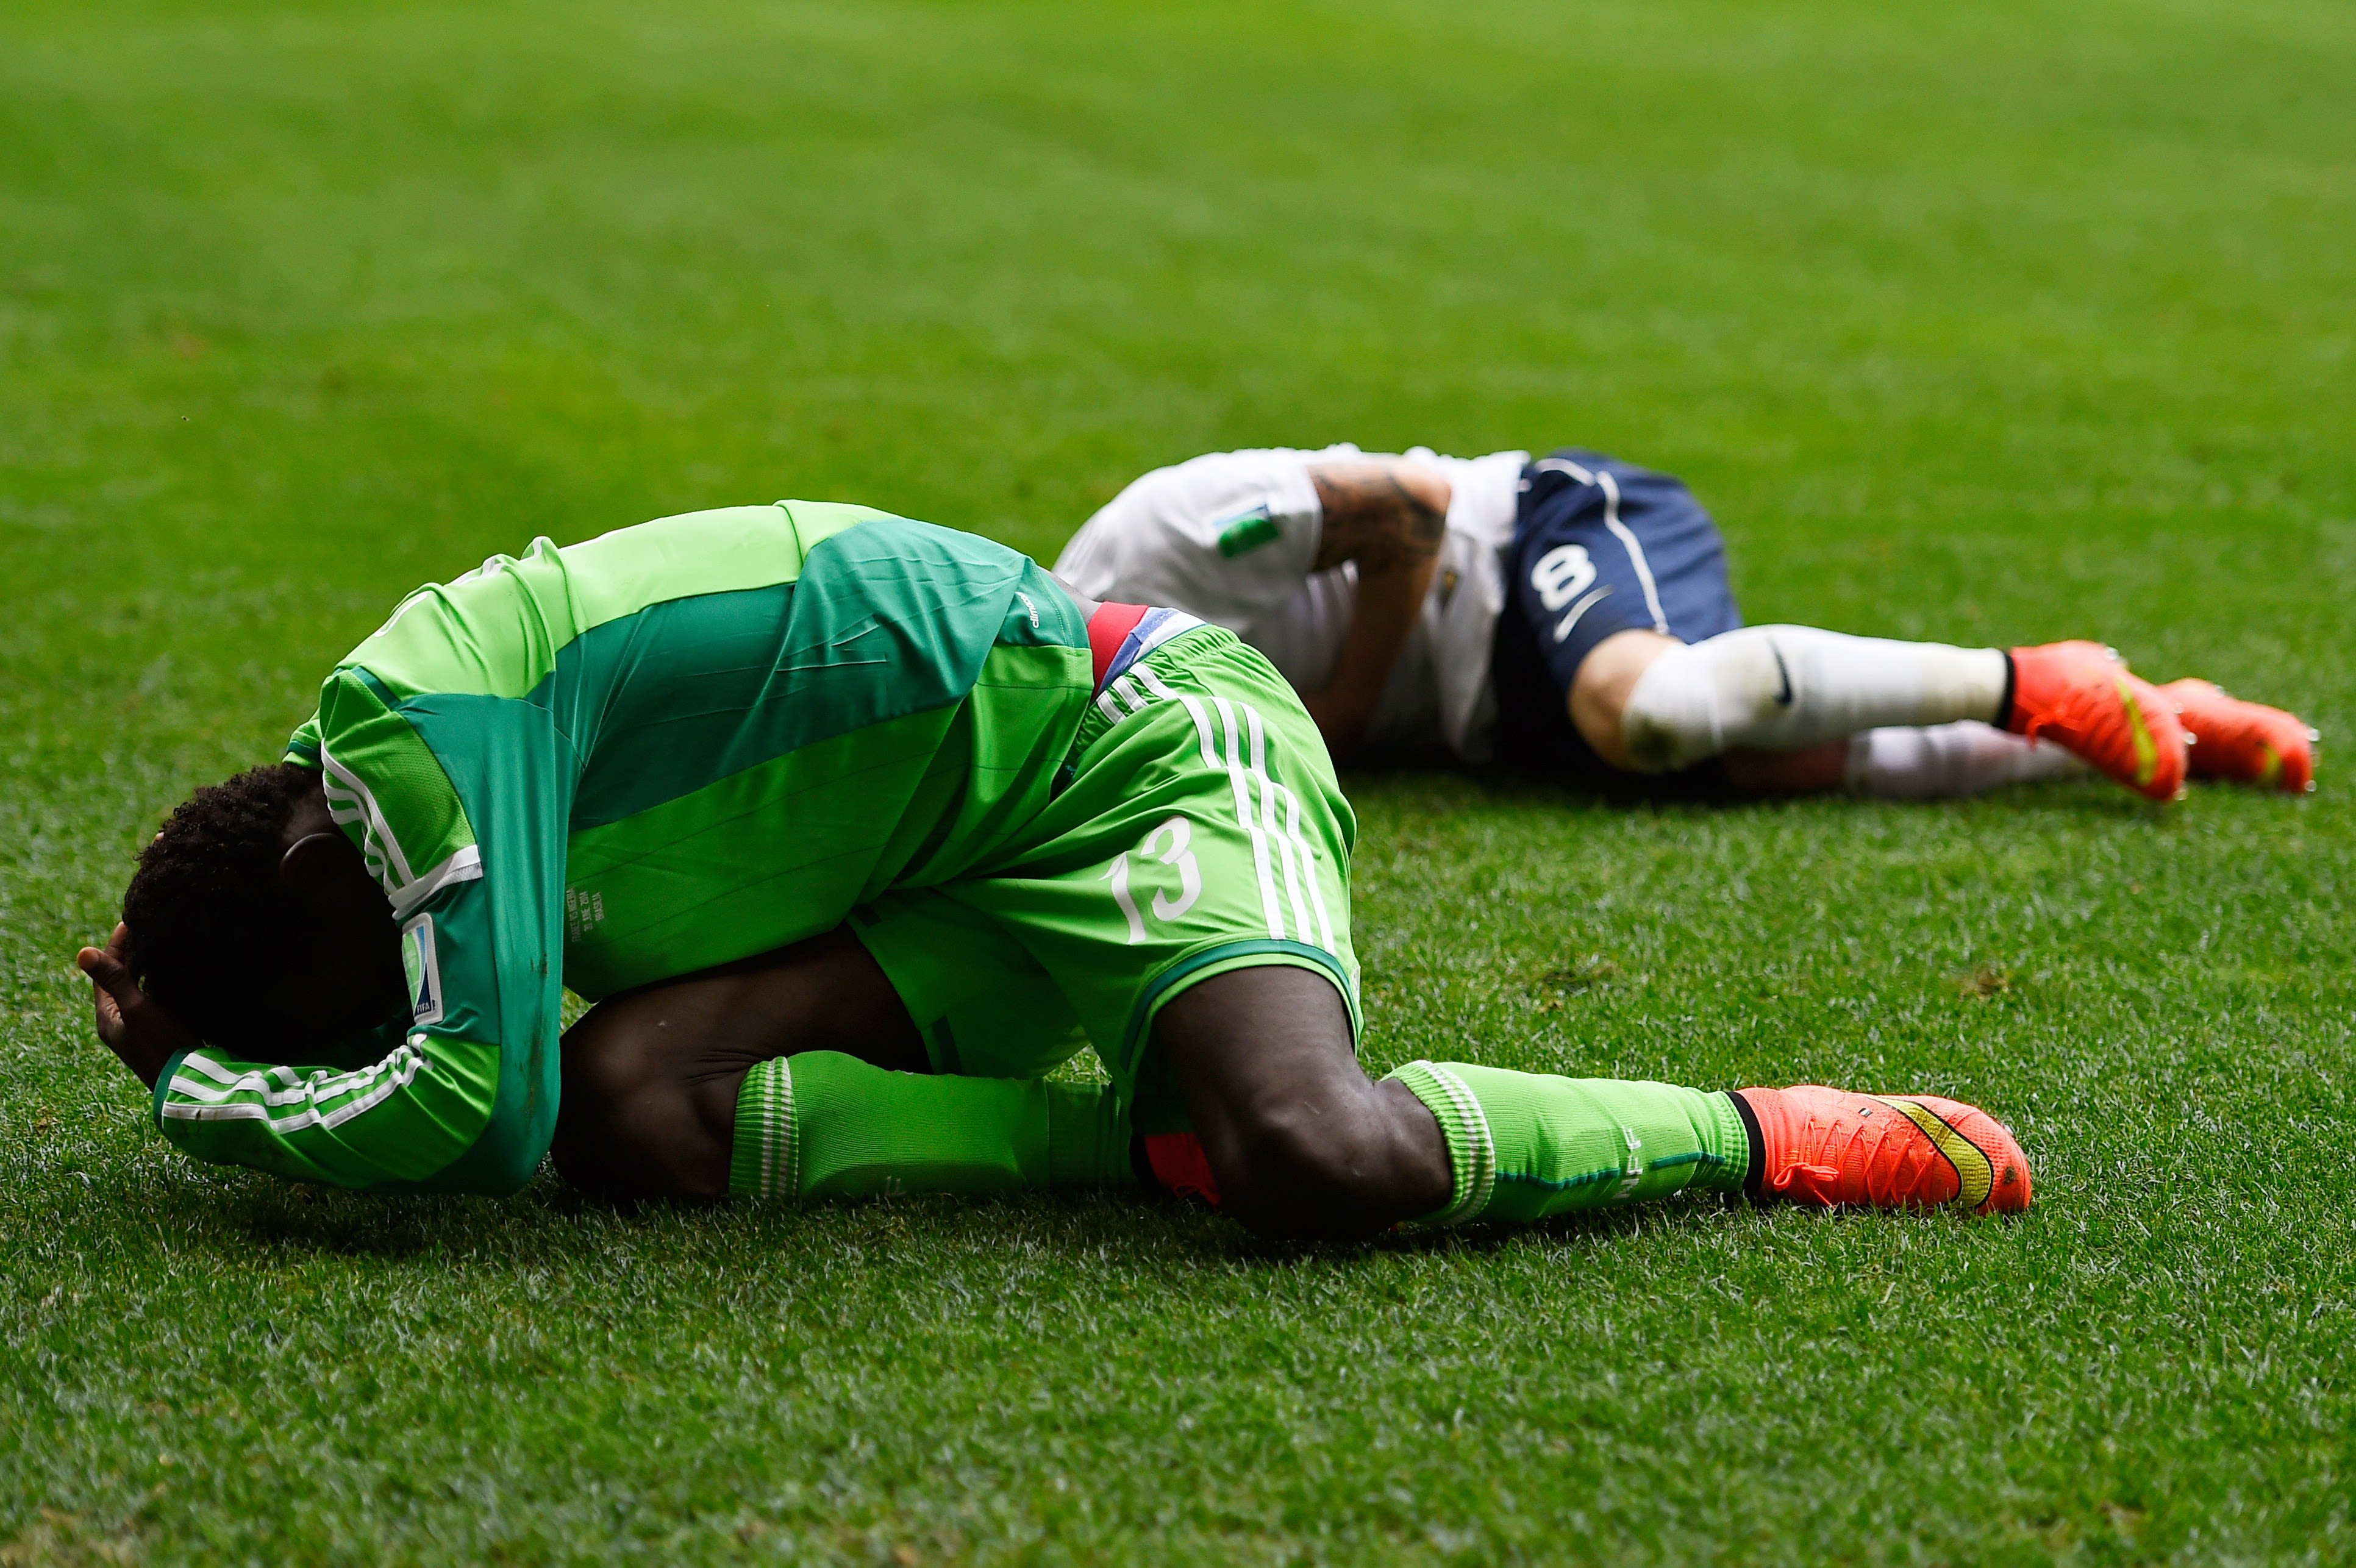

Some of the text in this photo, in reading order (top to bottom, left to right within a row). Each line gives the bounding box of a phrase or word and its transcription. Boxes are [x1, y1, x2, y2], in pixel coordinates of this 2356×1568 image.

[1531, 544, 1597, 611] 8
[1098, 816, 1202, 945] 13
[417, 1002, 430, 1014] FIFA
